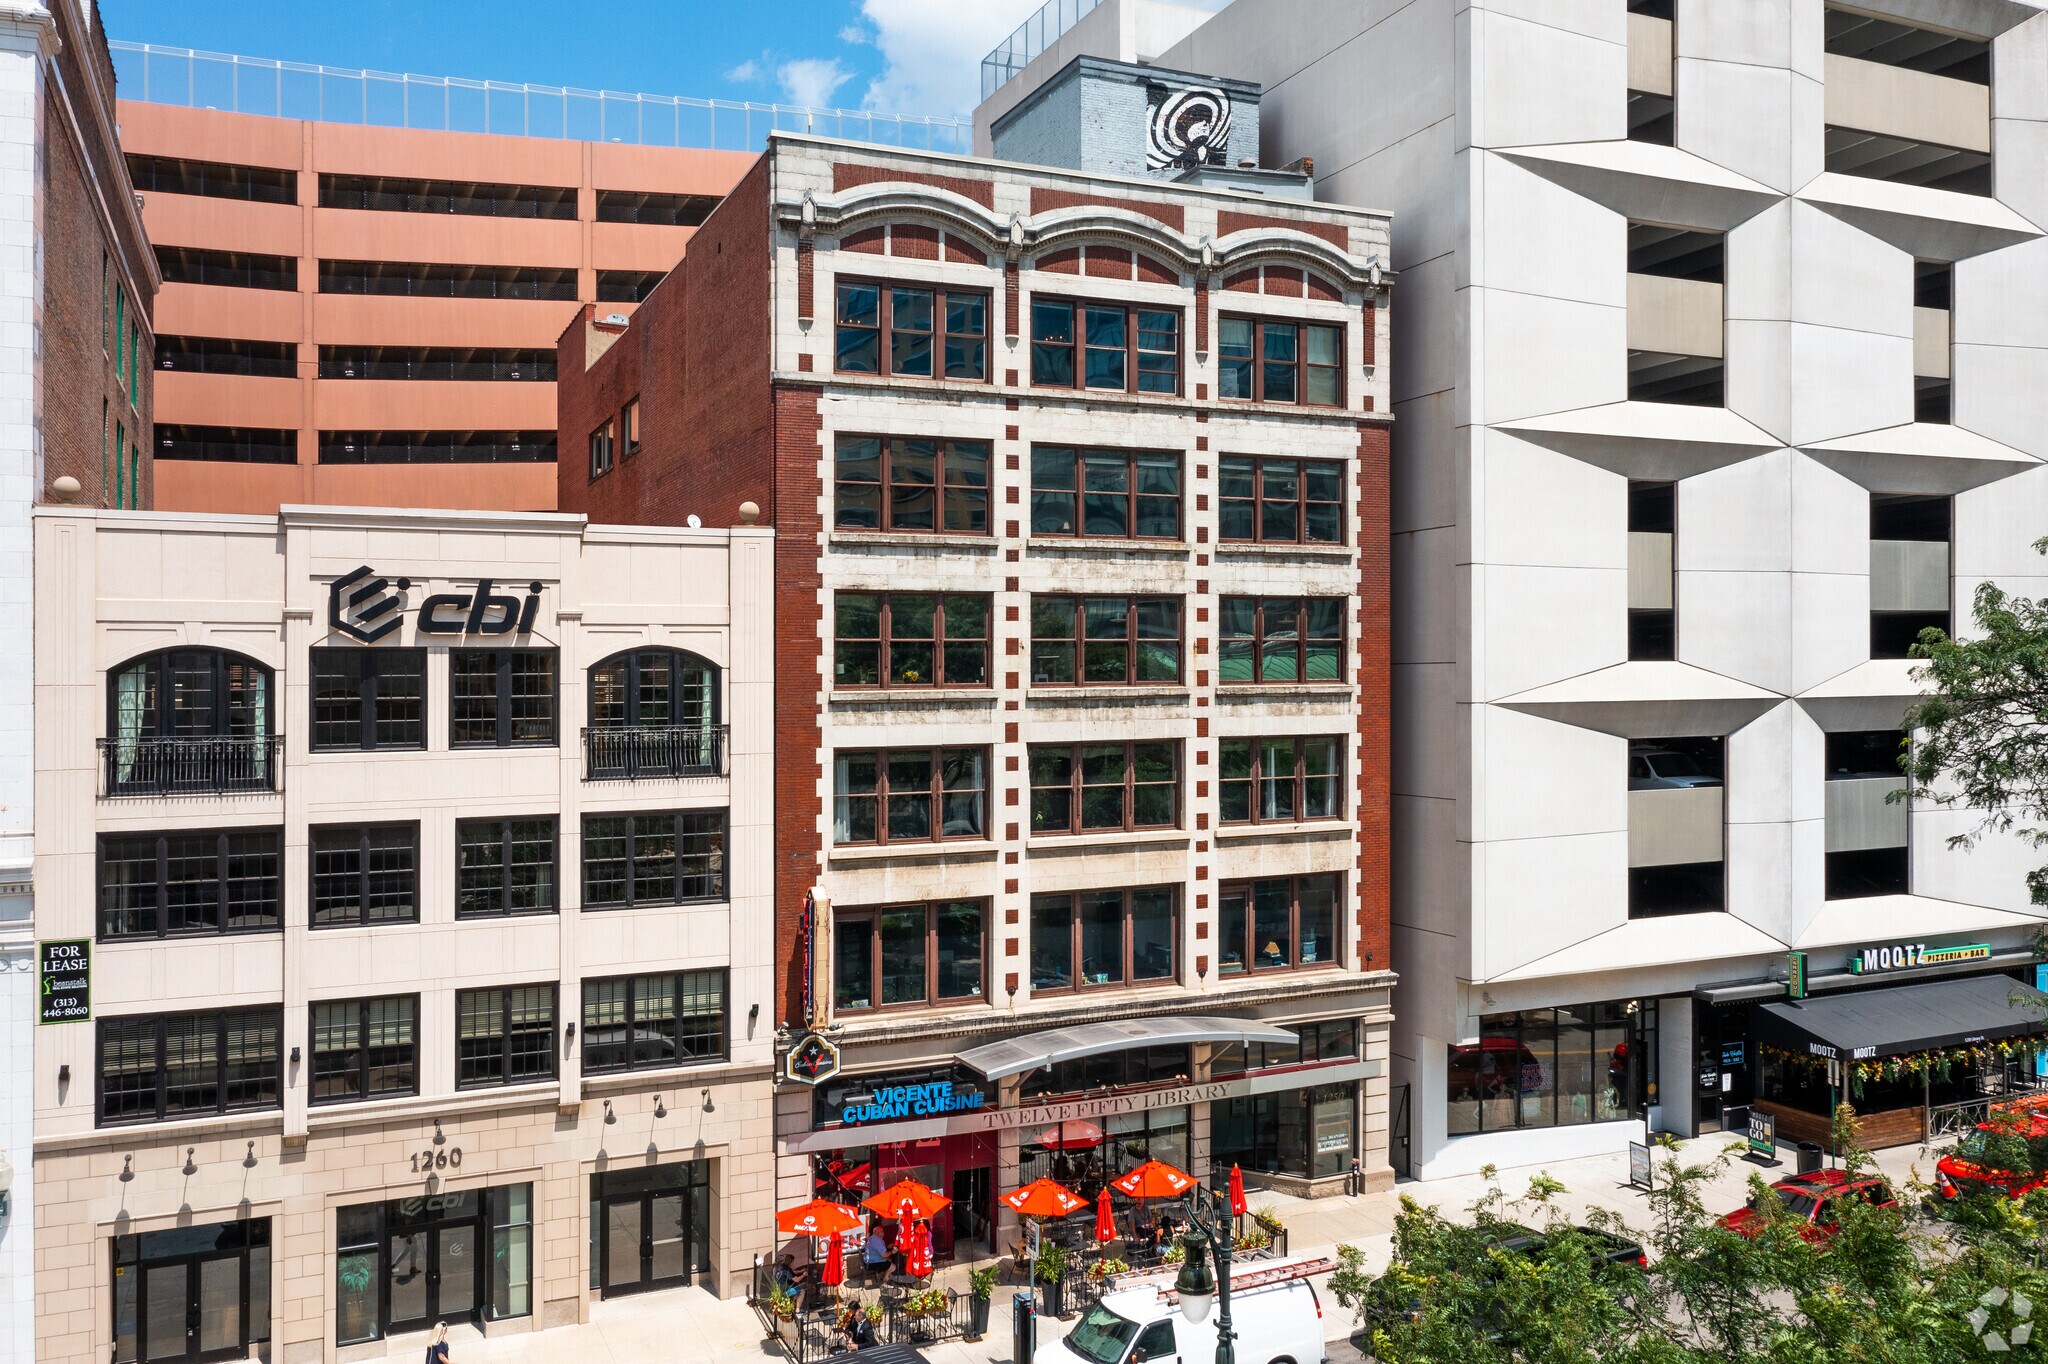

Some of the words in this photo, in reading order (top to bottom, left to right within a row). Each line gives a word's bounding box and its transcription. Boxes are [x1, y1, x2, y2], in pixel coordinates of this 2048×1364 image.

[417, 579, 543, 633] cbi
[50, 946, 81, 958] FOR
[1864, 944, 1926, 970] MOOTZ
[1927, 951, 1962, 963] PIZZERIA
[1970, 949, 1985, 958] BAR
[43, 959, 88, 972] LEASE
[53, 997, 77, 1008] (313)
[43, 1006, 88, 1018] 446-8060
[1809, 1042, 1836, 1058] MOOTZ
[1853, 1046, 1876, 1059] MOOTZ
[873, 1081, 953, 1105] VICENTE
[1322, 1092, 1345, 1104] 1250
[843, 1101, 909, 1123] CUBAN
[914, 1091, 985, 1115] CUISINE
[983, 1107, 1071, 1128] TWELVE
[1076, 1096, 1138, 1117] FIFTY
[1143, 1083, 1232, 1107] LIBRARY
[1749, 1117, 1763, 1130] TO
[1749, 1128, 1763, 1140] GO
[411, 1147, 462, 1173] 1260
